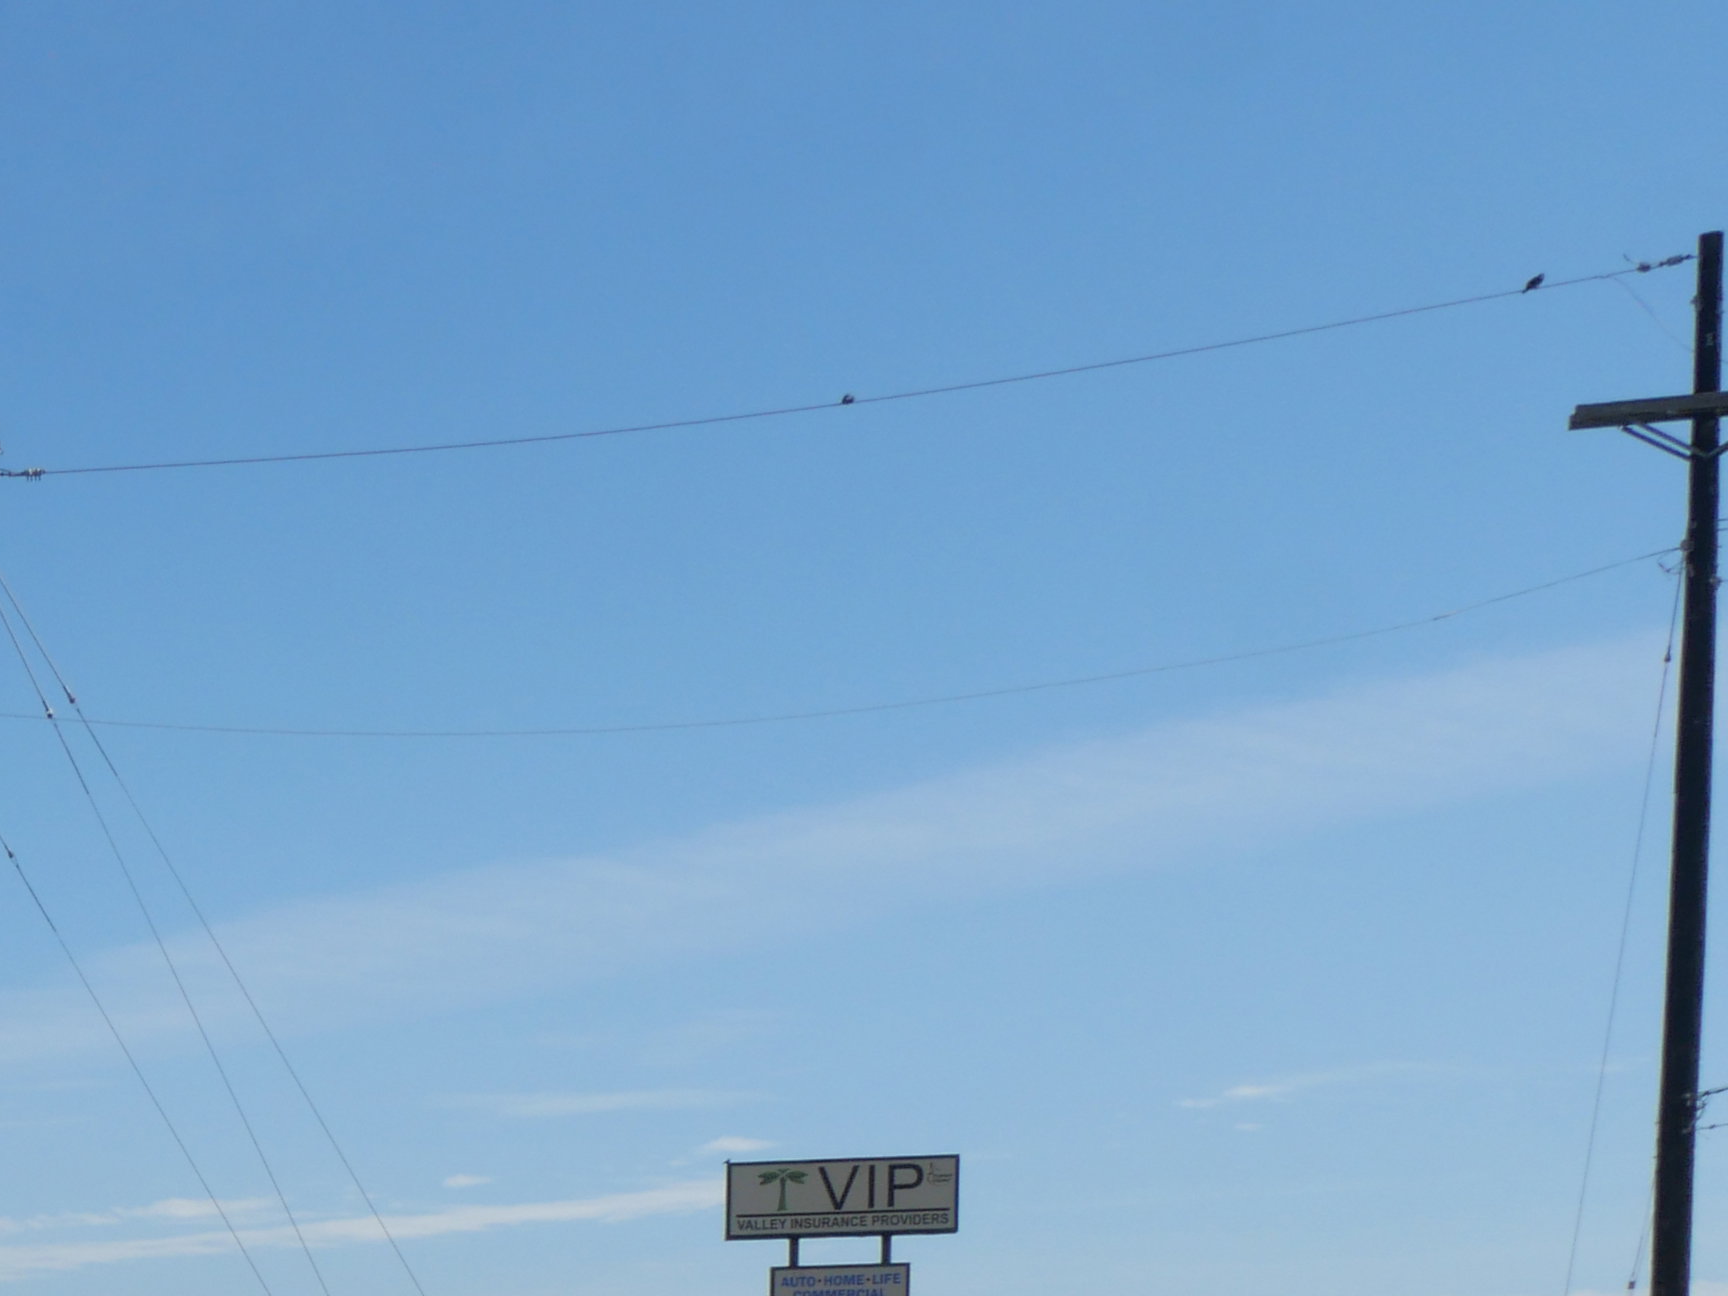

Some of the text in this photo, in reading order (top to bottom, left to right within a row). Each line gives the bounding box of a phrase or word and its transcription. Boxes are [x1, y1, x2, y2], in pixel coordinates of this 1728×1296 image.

[818, 1162, 924, 1210] VIP
[737, 1212, 949, 1231] VALLEY INSURANCE PROVIDERS
[781, 1272, 901, 1287] AUTO HOME LIFE
